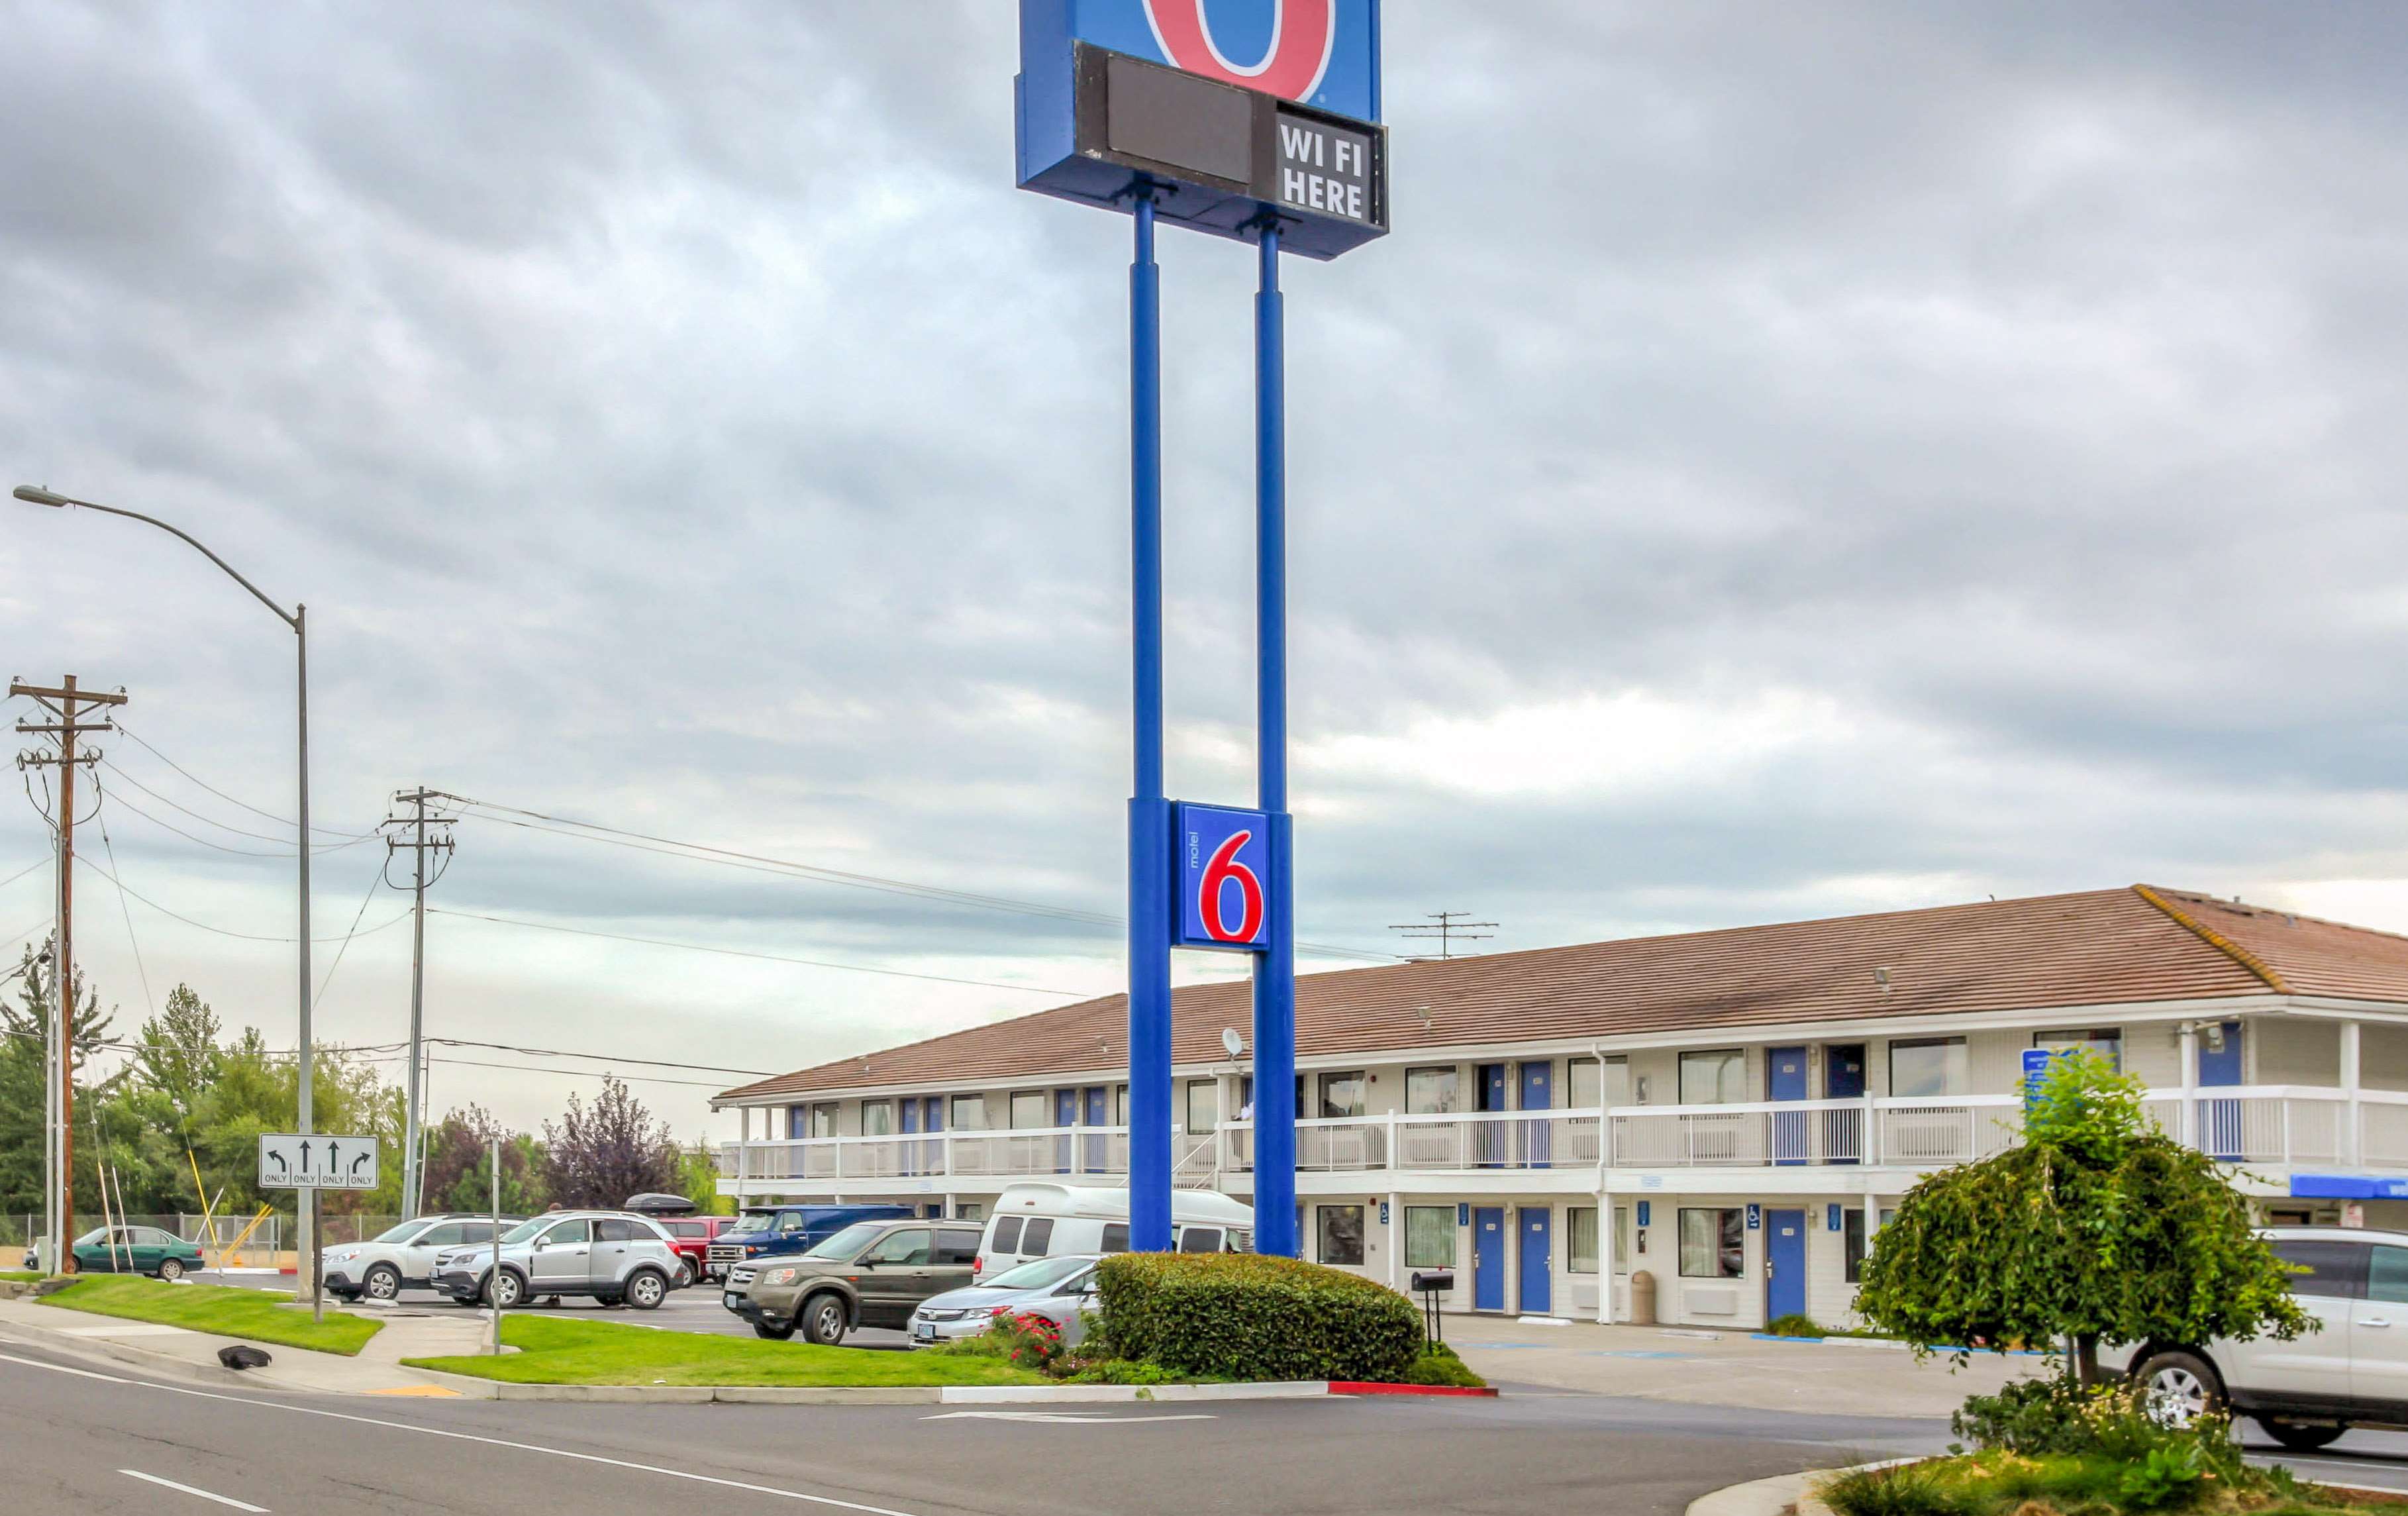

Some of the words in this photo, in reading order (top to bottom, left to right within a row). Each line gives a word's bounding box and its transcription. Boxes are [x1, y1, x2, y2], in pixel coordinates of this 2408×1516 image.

[1280, 124, 1323, 167] WI
[1336, 139, 1362, 177] FI
[1283, 168, 1362, 219] HERE
[1189, 832, 1199, 868] motel
[1198, 829, 1264, 943] 6
[351, 1176, 372, 1185] ONLY
